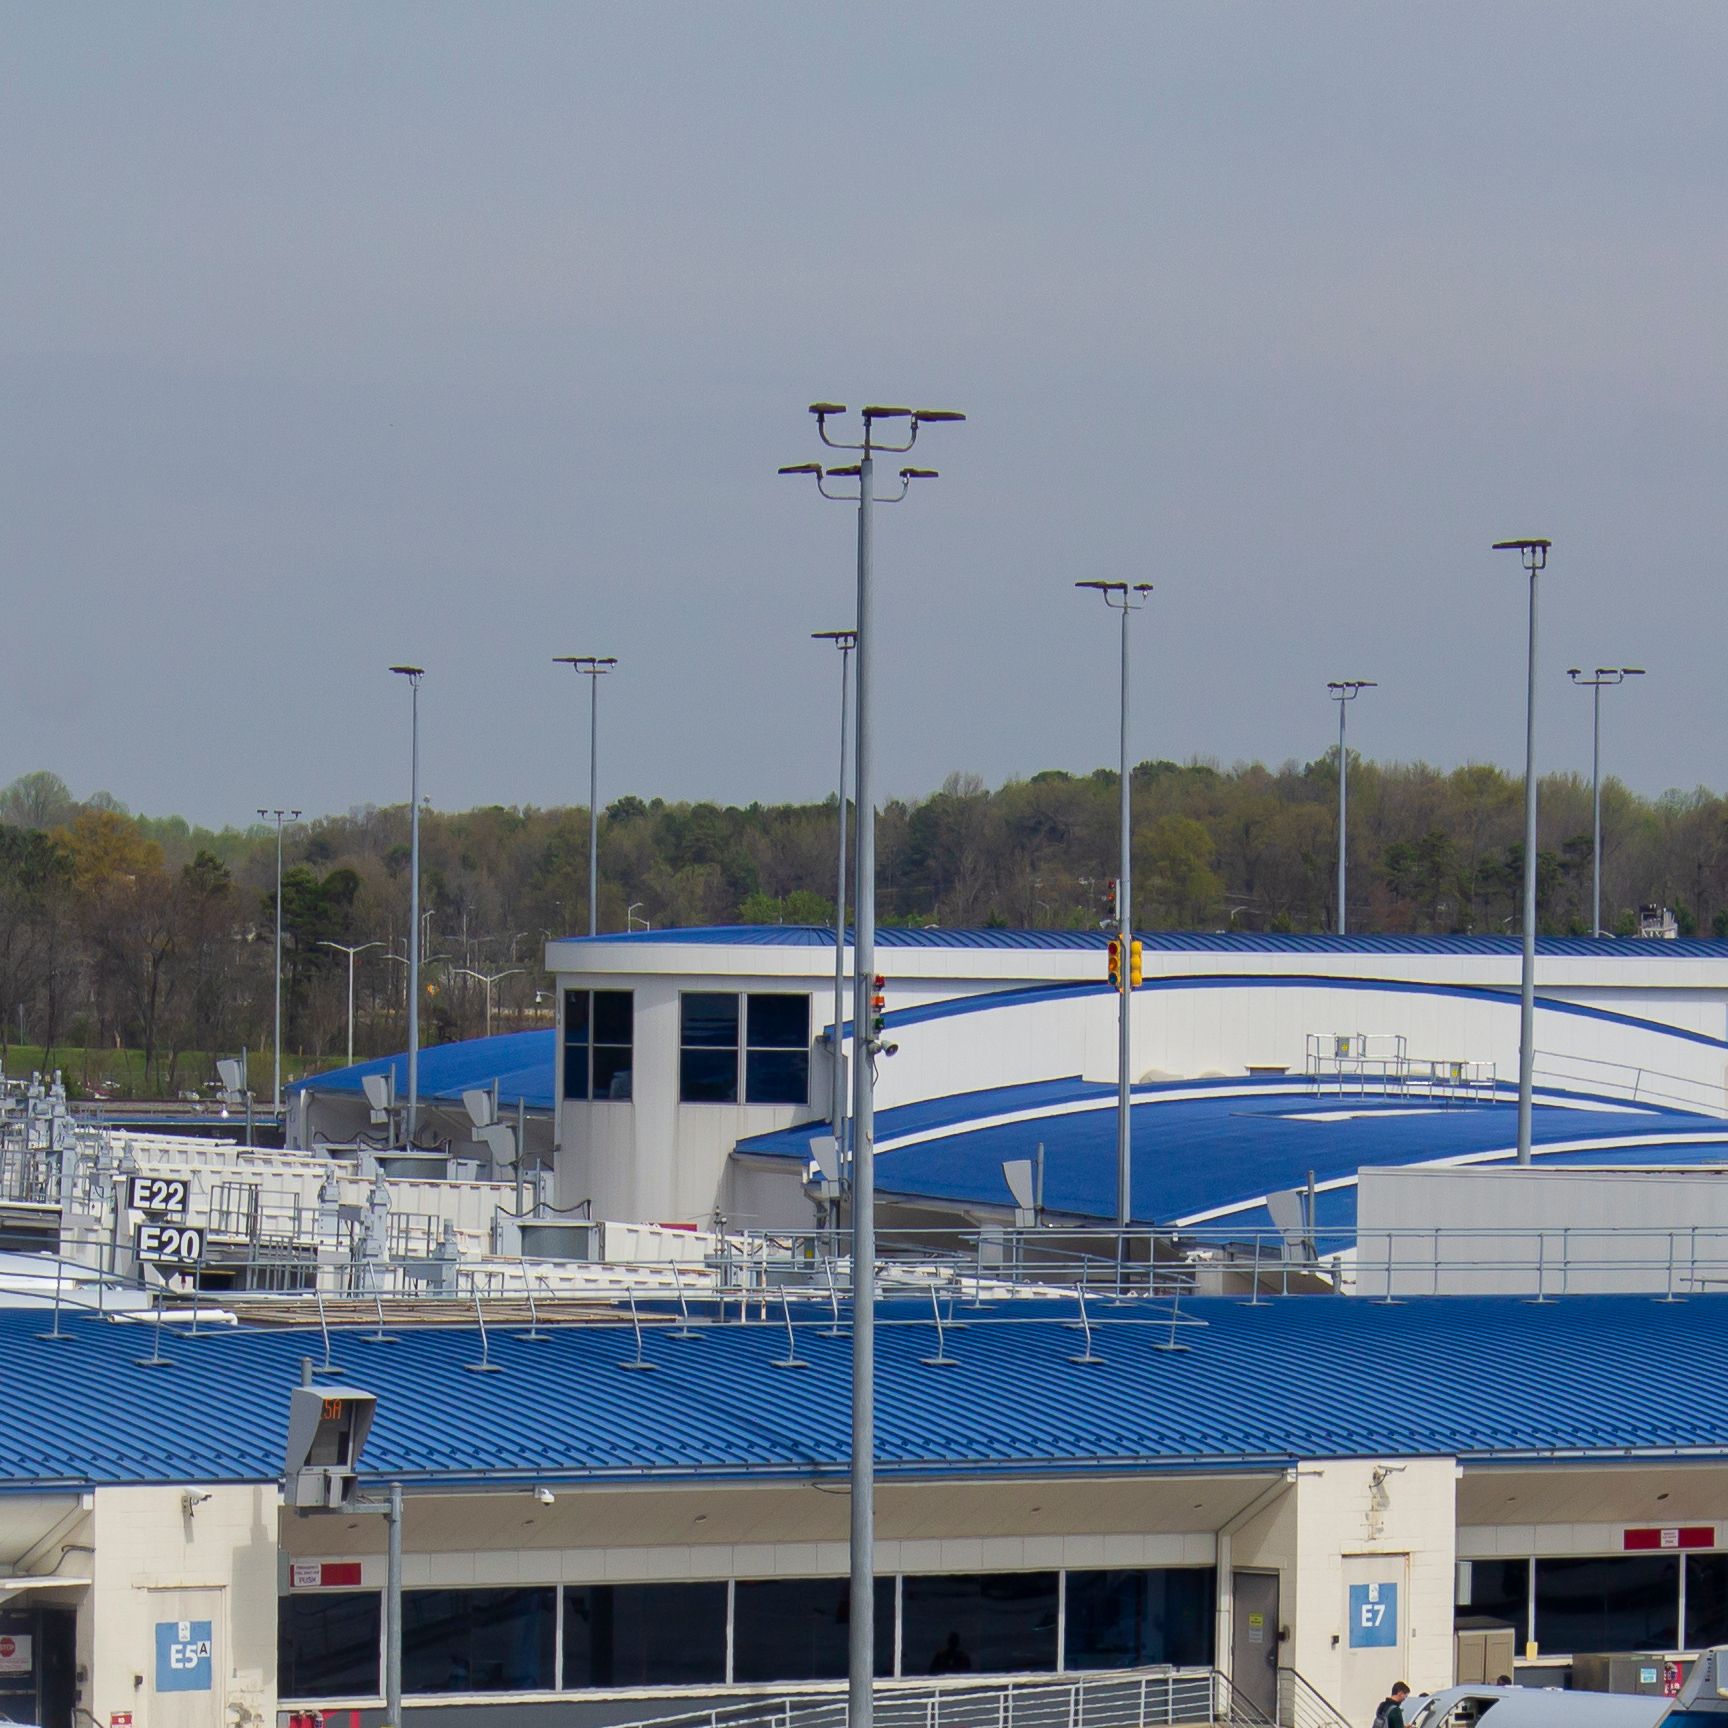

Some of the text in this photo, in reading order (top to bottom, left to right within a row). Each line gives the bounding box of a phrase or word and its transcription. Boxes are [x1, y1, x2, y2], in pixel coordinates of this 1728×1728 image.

[133, 1178, 184, 1211] E22
[139, 1226, 200, 1263] E20
[1361, 1604, 1386, 1627] E7
